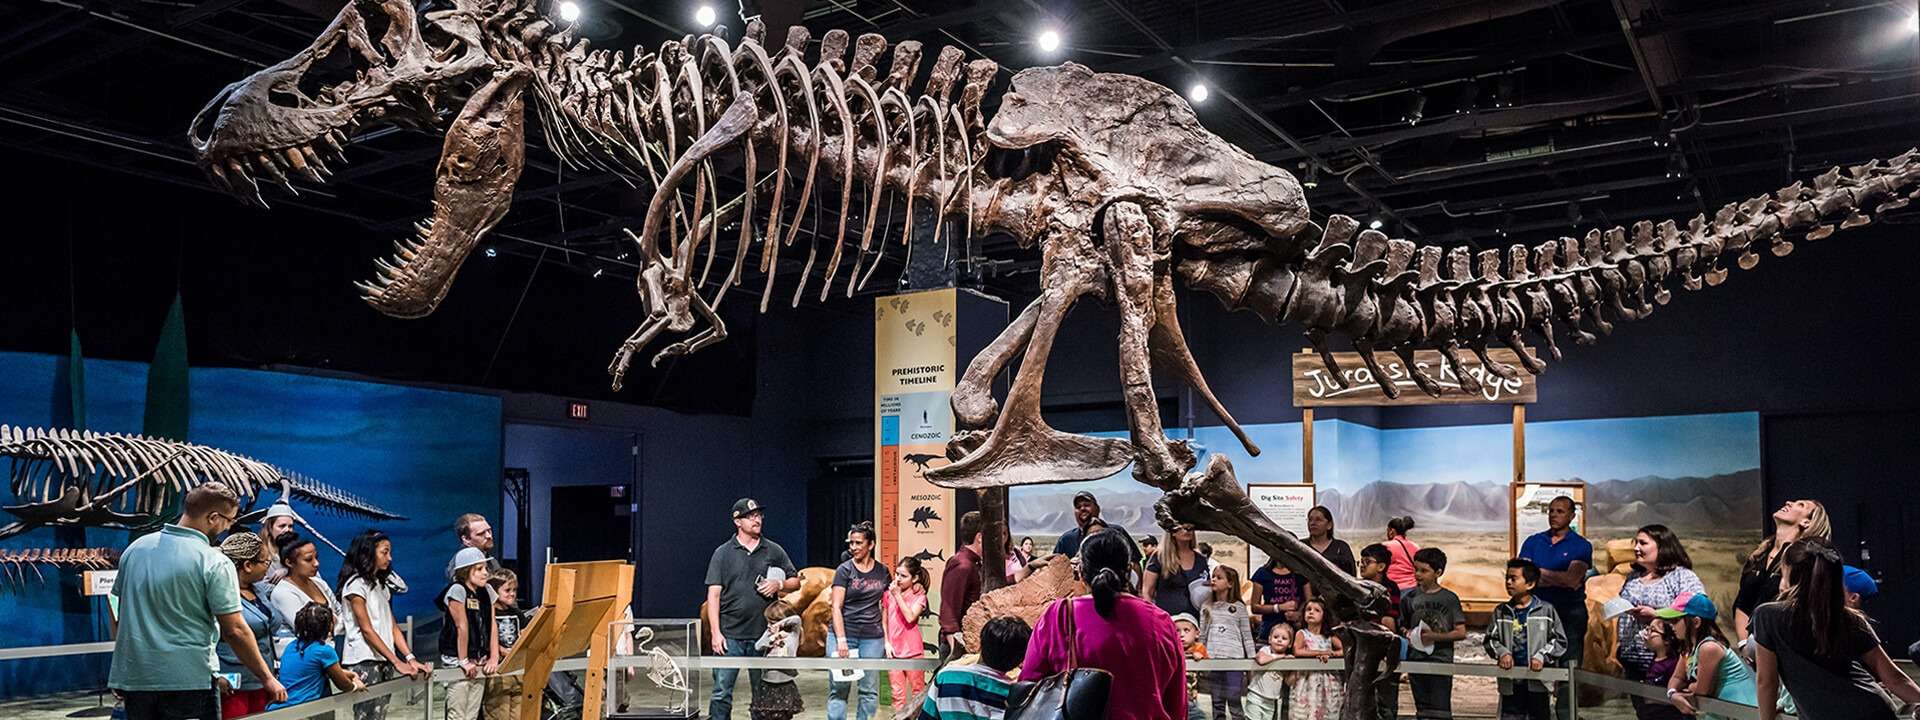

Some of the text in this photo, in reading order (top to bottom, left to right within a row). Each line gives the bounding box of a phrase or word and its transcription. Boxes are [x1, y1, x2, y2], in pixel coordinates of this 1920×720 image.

[892, 365, 945, 376] PREHISTORIC
[900, 376, 937, 385] TIMELINE
[572, 404, 587, 418] EXIT
